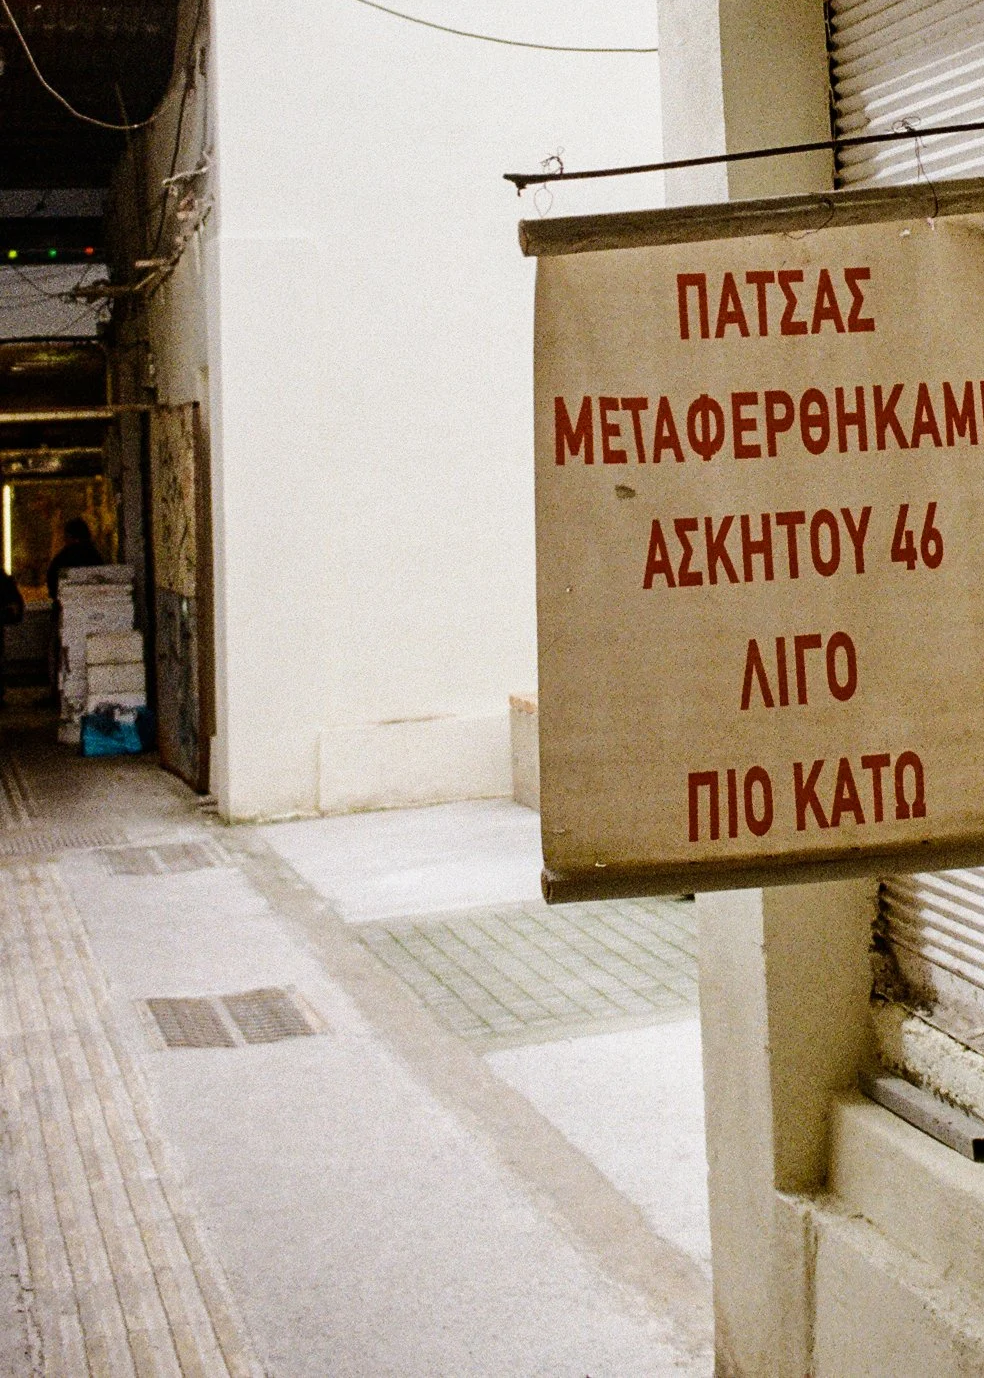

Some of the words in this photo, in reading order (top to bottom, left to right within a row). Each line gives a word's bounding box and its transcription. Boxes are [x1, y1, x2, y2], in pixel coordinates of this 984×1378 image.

[676, 267, 876, 340] ΠΑΤΣΑΣ
[643, 506, 873, 590] ΑΣΚΗΤΟΥ
[890, 502, 945, 571] 46
[740, 631, 858, 710] ΛΙΓΟ
[687, 766, 774, 842] ΠΙΟ
[793, 750, 927, 831] ΚΑΤΩ
